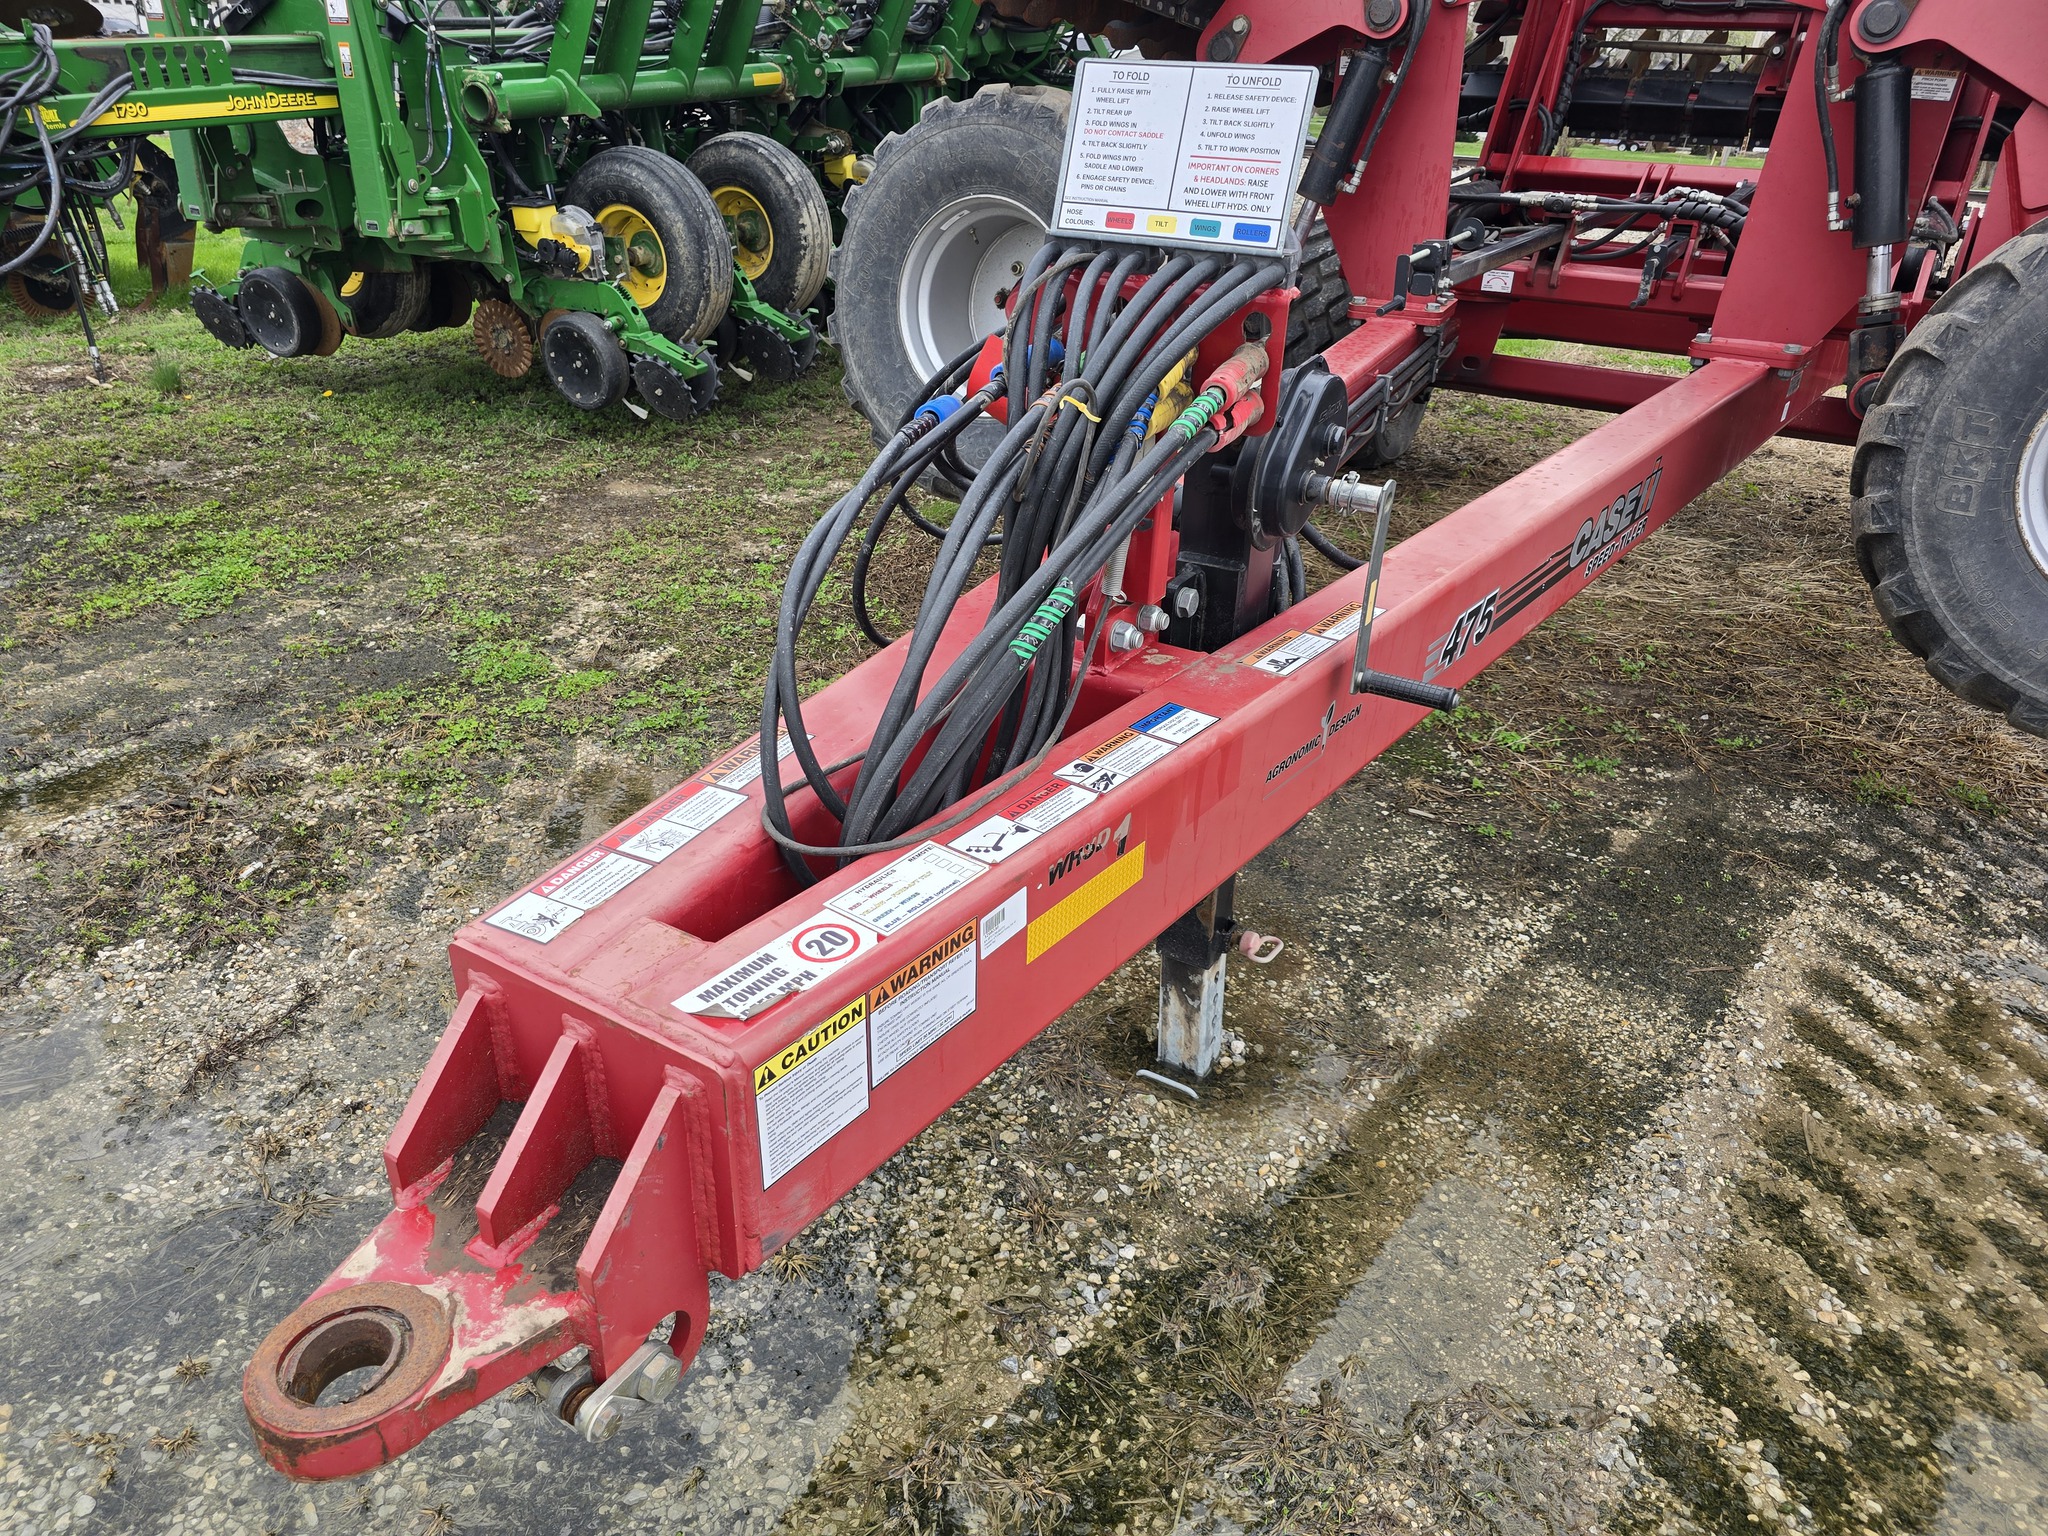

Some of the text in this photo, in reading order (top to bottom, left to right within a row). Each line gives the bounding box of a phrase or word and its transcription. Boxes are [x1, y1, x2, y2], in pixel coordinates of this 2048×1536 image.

[1112, 70, 1150, 81] TO FOLD
[1924, 69, 1957, 77] WARNING
[1227, 75, 1282, 87] TO UNFOLD
[226, 91, 316, 111] JOHN DEERE
[1213, 93, 1244, 101] RELEASE
[1245, 94, 1270, 102] SAFETY
[111, 102, 148, 119] 1790
[1211, 106, 1231, 114] RAISE
[1223, 119, 1242, 127] BACK
[1243, 120, 1275, 129] SLIGHTLY
[1107, 129, 1138, 137] CONTACT
[1138, 131, 1164, 139] SADDLE
[1206, 131, 1233, 139] UNFOLD
[1234, 132, 1256, 141] WINGS
[1118, 142, 1148, 150] SLIGHTLY
[1249, 147, 1281, 155] POSITION
[1121, 165, 1144, 173] LOWER
[1187, 162, 1280, 176] IMPORTANT ON CORNERS
[1082, 174, 1106, 182] ENGAGE
[1107, 175, 1131, 183] SAFETY
[1200, 175, 1247, 187] HEADLANDS:
[1247, 179, 1269, 188] RAISE
[1104, 185, 1127, 193] CHAINS
[1183, 186, 1275, 201] AND LOWER WITH FRONT
[1184, 198, 1210, 208] WHEEL
[1211, 201, 1227, 210] LIFT
[1250, 204, 1271, 213] ONLY
[1065, 218, 1096, 226] COLOURS:
[1107, 216, 1133, 225] WHEELS
[1154, 220, 1169, 228] TILT
[1194, 224, 1217, 233] WINGS
[1236, 228, 1268, 237] ROLLERS
[1322, 603, 1362, 629] WARNING
[1438, 586, 1500, 671] 475
[1260, 635, 1293, 656] WARNING
[1139, 706, 1175, 730] IMPORTANT
[718, 726, 789, 771] WARNG
[1094, 731, 1134, 755] WARNING
[1265, 704, 1362, 784] AGRONOMIC DESIGN
[1020, 782, 1063, 811] DANGER
[636, 794, 688, 827] DANGER
[1113, 812, 1132, 860] 1
[550, 849, 605, 885] DANGER
[854, 868, 897, 895] HYDRAULICS
[805, 930, 849, 957] 20
[890, 925, 974, 994] WARNING
[696, 952, 778, 1004] MAXIMUM
[721, 966, 790, 1009] TOWING
[781, 1002, 863, 1071] CAUTION
